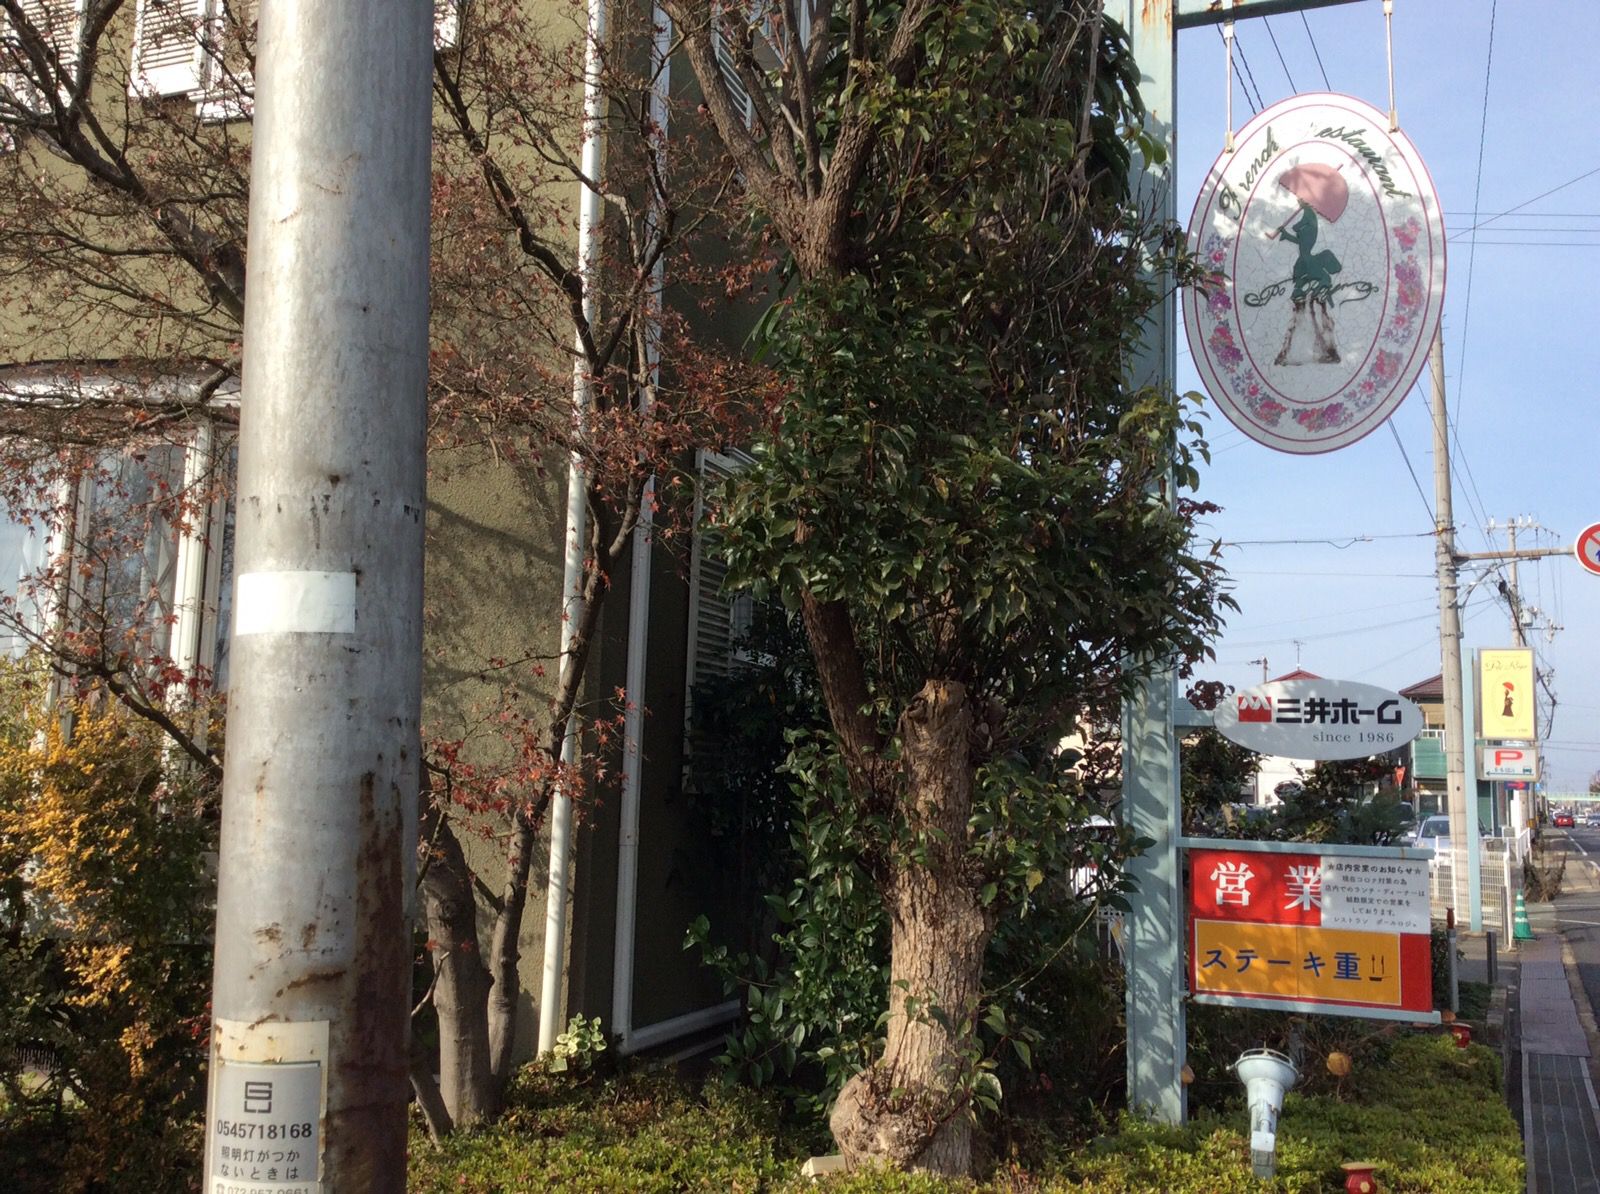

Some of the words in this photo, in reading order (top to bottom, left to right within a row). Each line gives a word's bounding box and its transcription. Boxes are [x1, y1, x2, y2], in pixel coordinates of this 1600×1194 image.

[1311, 122, 1412, 199] estaurant
[1276, 697, 1402, 725] 三井ホーム
[1312, 731, 1351, 743] since
[1358, 732, 1395, 743] 1986
[1495, 750, 1523, 766] P
[1202, 950, 1361, 981] ステーキ重
[217, 1119, 312, 1139] 0545718168
[221, 1145, 300, 1163] 照明灯がつか
[220, 1163, 299, 1180] ないときは
